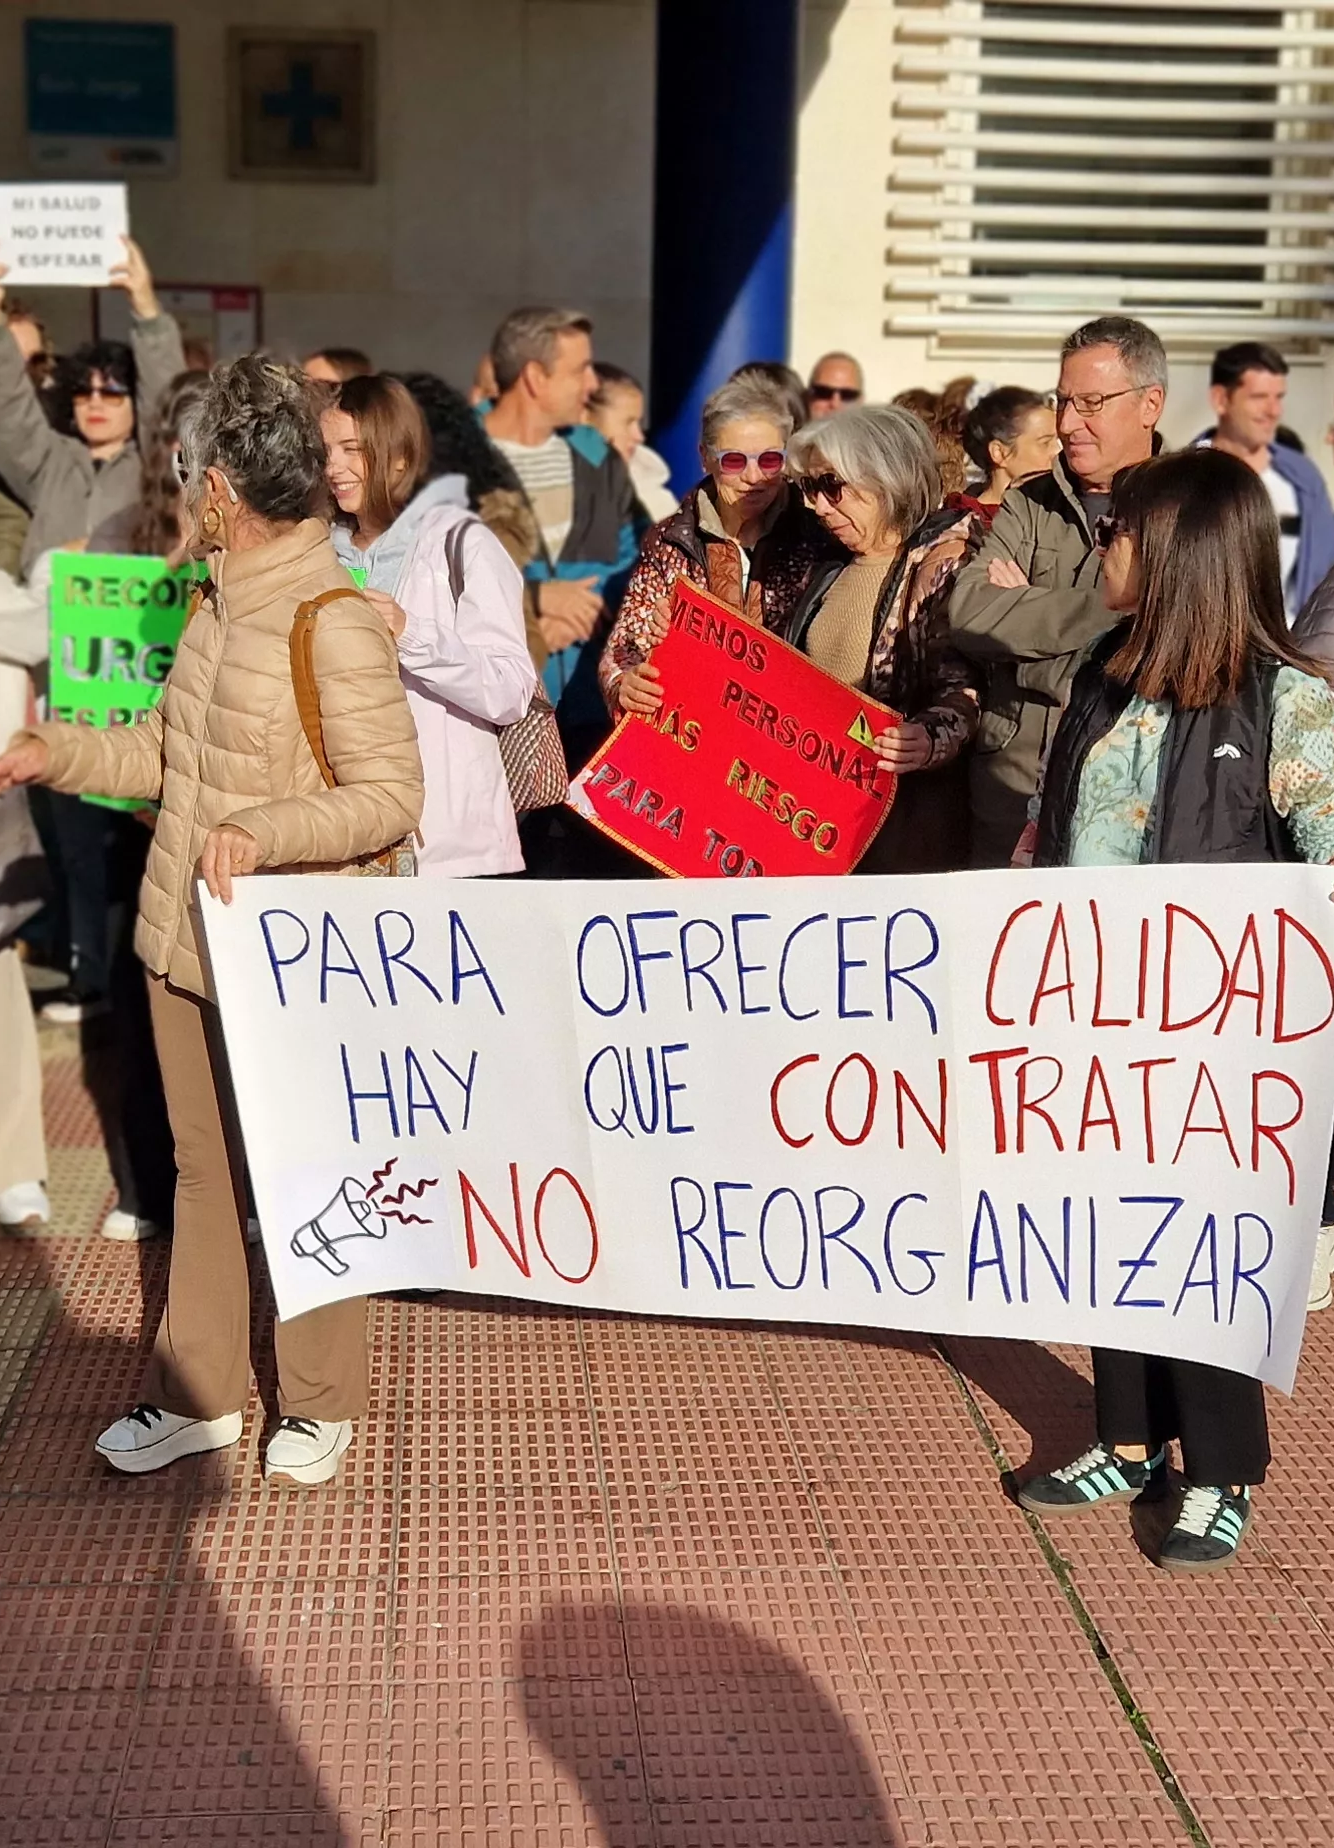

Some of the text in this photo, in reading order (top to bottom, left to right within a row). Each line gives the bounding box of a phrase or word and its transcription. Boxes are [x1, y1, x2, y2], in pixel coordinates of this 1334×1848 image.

[11, 225, 103, 240] NO PUEDE
[12, 196, 102, 211] MI SALUD
[17, 253, 103, 268] ESPERAR
[720, 677, 885, 801] PERSONAL
[590, 762, 685, 841] PARA
[725, 756, 841, 855] RIESGO
[259, 909, 505, 1016] PARA
[577, 908, 940, 1034] OFRECER
[340, 1042, 1305, 1205] HAY QUE CONTRATAR
[457, 1161, 1274, 1358] NO REORGANIZAR
